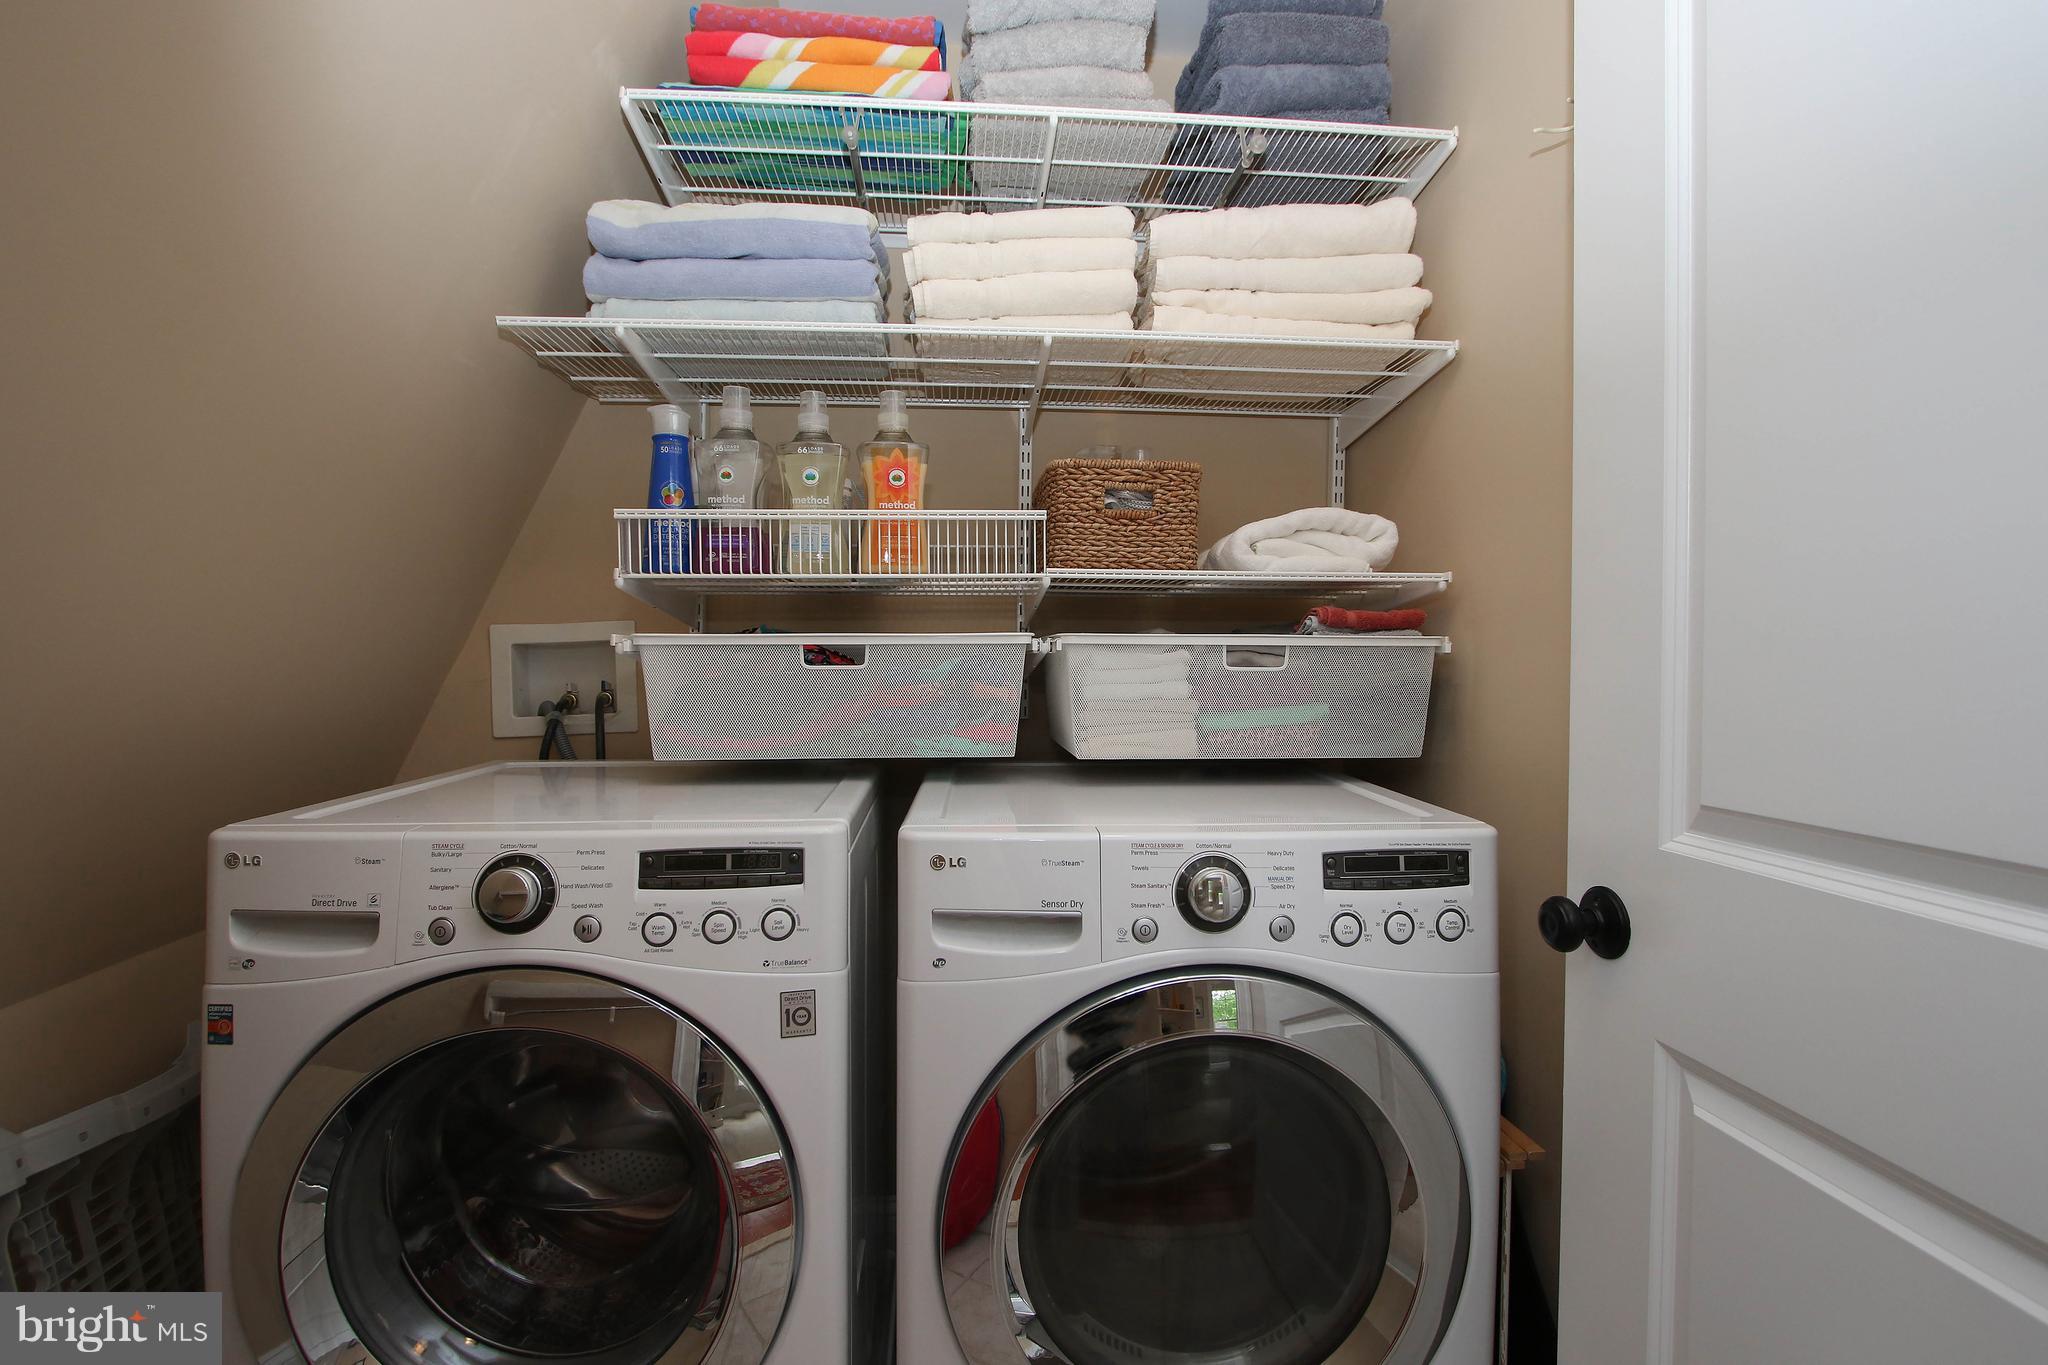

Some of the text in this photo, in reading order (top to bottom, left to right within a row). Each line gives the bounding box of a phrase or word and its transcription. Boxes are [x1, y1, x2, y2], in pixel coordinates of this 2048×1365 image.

[708, 495, 745, 503] method
[792, 496, 830, 504] method
[879, 501, 916, 509] method
[243, 855, 263, 866] LG
[949, 857, 967, 868] LG
[312, 898, 357, 907] Direct Drive
[1041, 899, 1084, 909] Sensor Dry
[784, 1006, 812, 1028] 10
